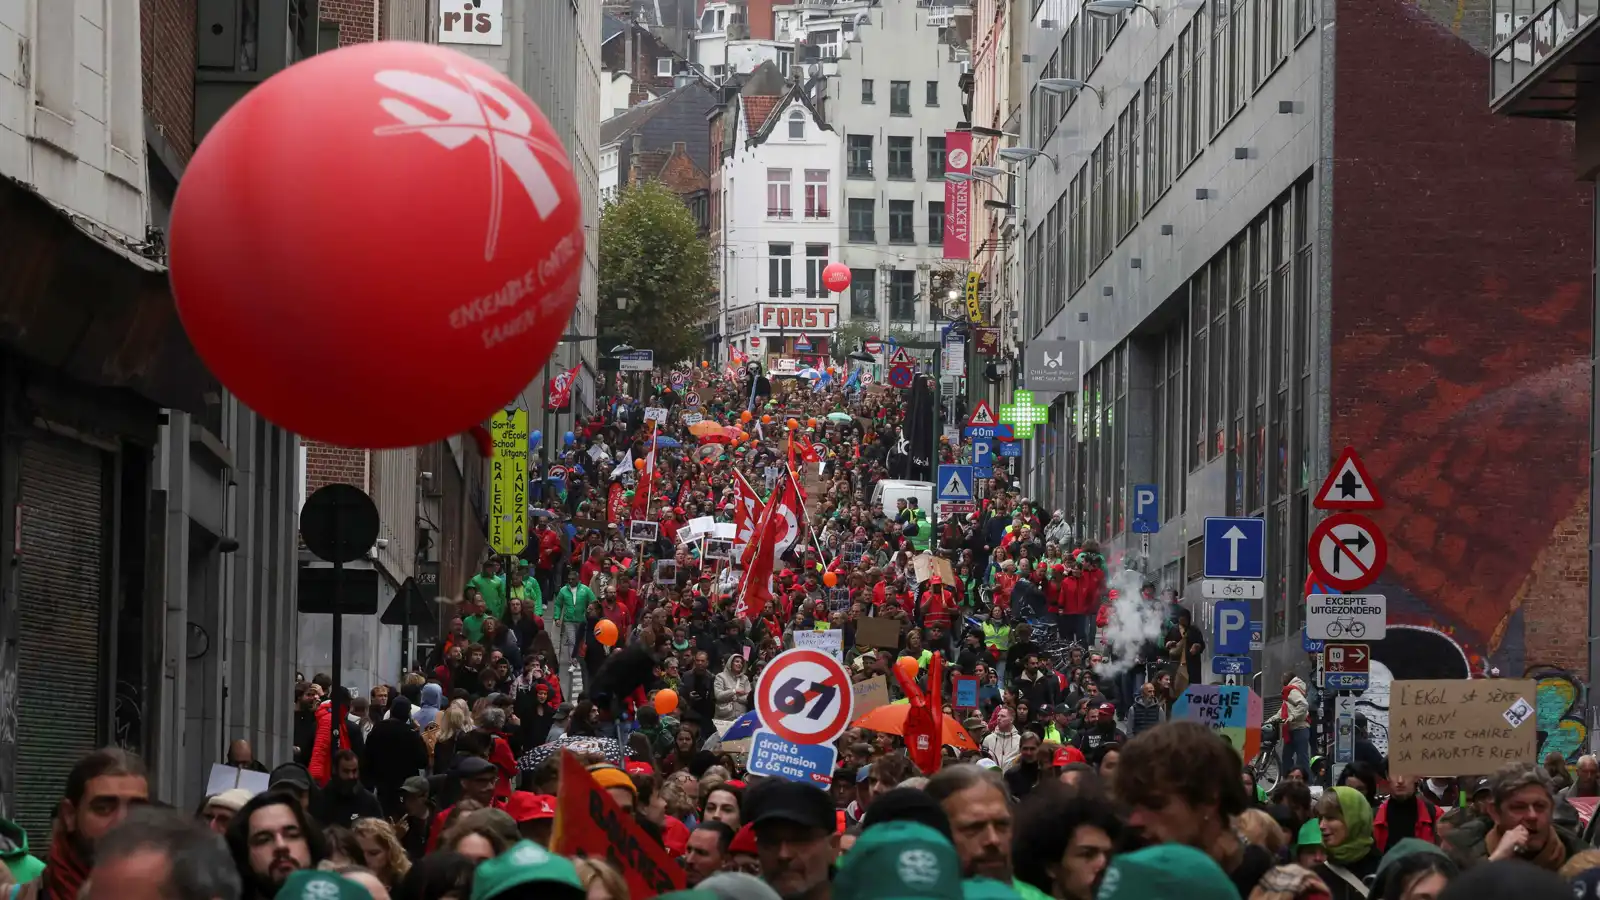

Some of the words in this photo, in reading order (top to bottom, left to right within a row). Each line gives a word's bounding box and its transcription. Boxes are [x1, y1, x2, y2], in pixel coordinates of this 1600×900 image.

[439, 3, 492, 34] ris
[955, 180, 968, 243] ALEXIENS
[449, 269, 536, 329] ENSEMBLE
[967, 276, 978, 317] SNACK
[762, 307, 835, 328] FORST
[492, 420, 516, 430] Sortie
[971, 427, 994, 438] 40m
[502, 430, 527, 440] d'Ecole
[492, 440, 516, 448] School
[501, 449, 527, 460] Uitgang
[974, 442, 989, 464] P
[493, 461, 503, 546] RALENTIR
[514, 462, 525, 546] LANGZAAM
[1137, 490, 1155, 515] P
[1325, 597, 1368, 606] EXCEPTE
[1311, 606, 1382, 615] UITGEZONDERD
[1219, 609, 1245, 646] P
[1332, 651, 1341, 659] 10
[774, 677, 837, 721] 67
[1184, 691, 1241, 706] TOUCHE
[1199, 706, 1221, 720] PAS
[1505, 711, 1520, 725] EGO
[1400, 717, 1407, 729] A
[1399, 732, 1413, 743] SA
[1421, 730, 1457, 741] KOUTE
[759, 739, 789, 752] droit
[791, 743, 799, 755] à
[1398, 750, 1412, 762] SA
[1421, 745, 1485, 761] RAPORTTE
[757, 747, 768, 759] la
[771, 752, 817, 770] pension
[755, 758, 763, 769] à
[765, 761, 781, 773] 65
[782, 766, 804, 778] ans
